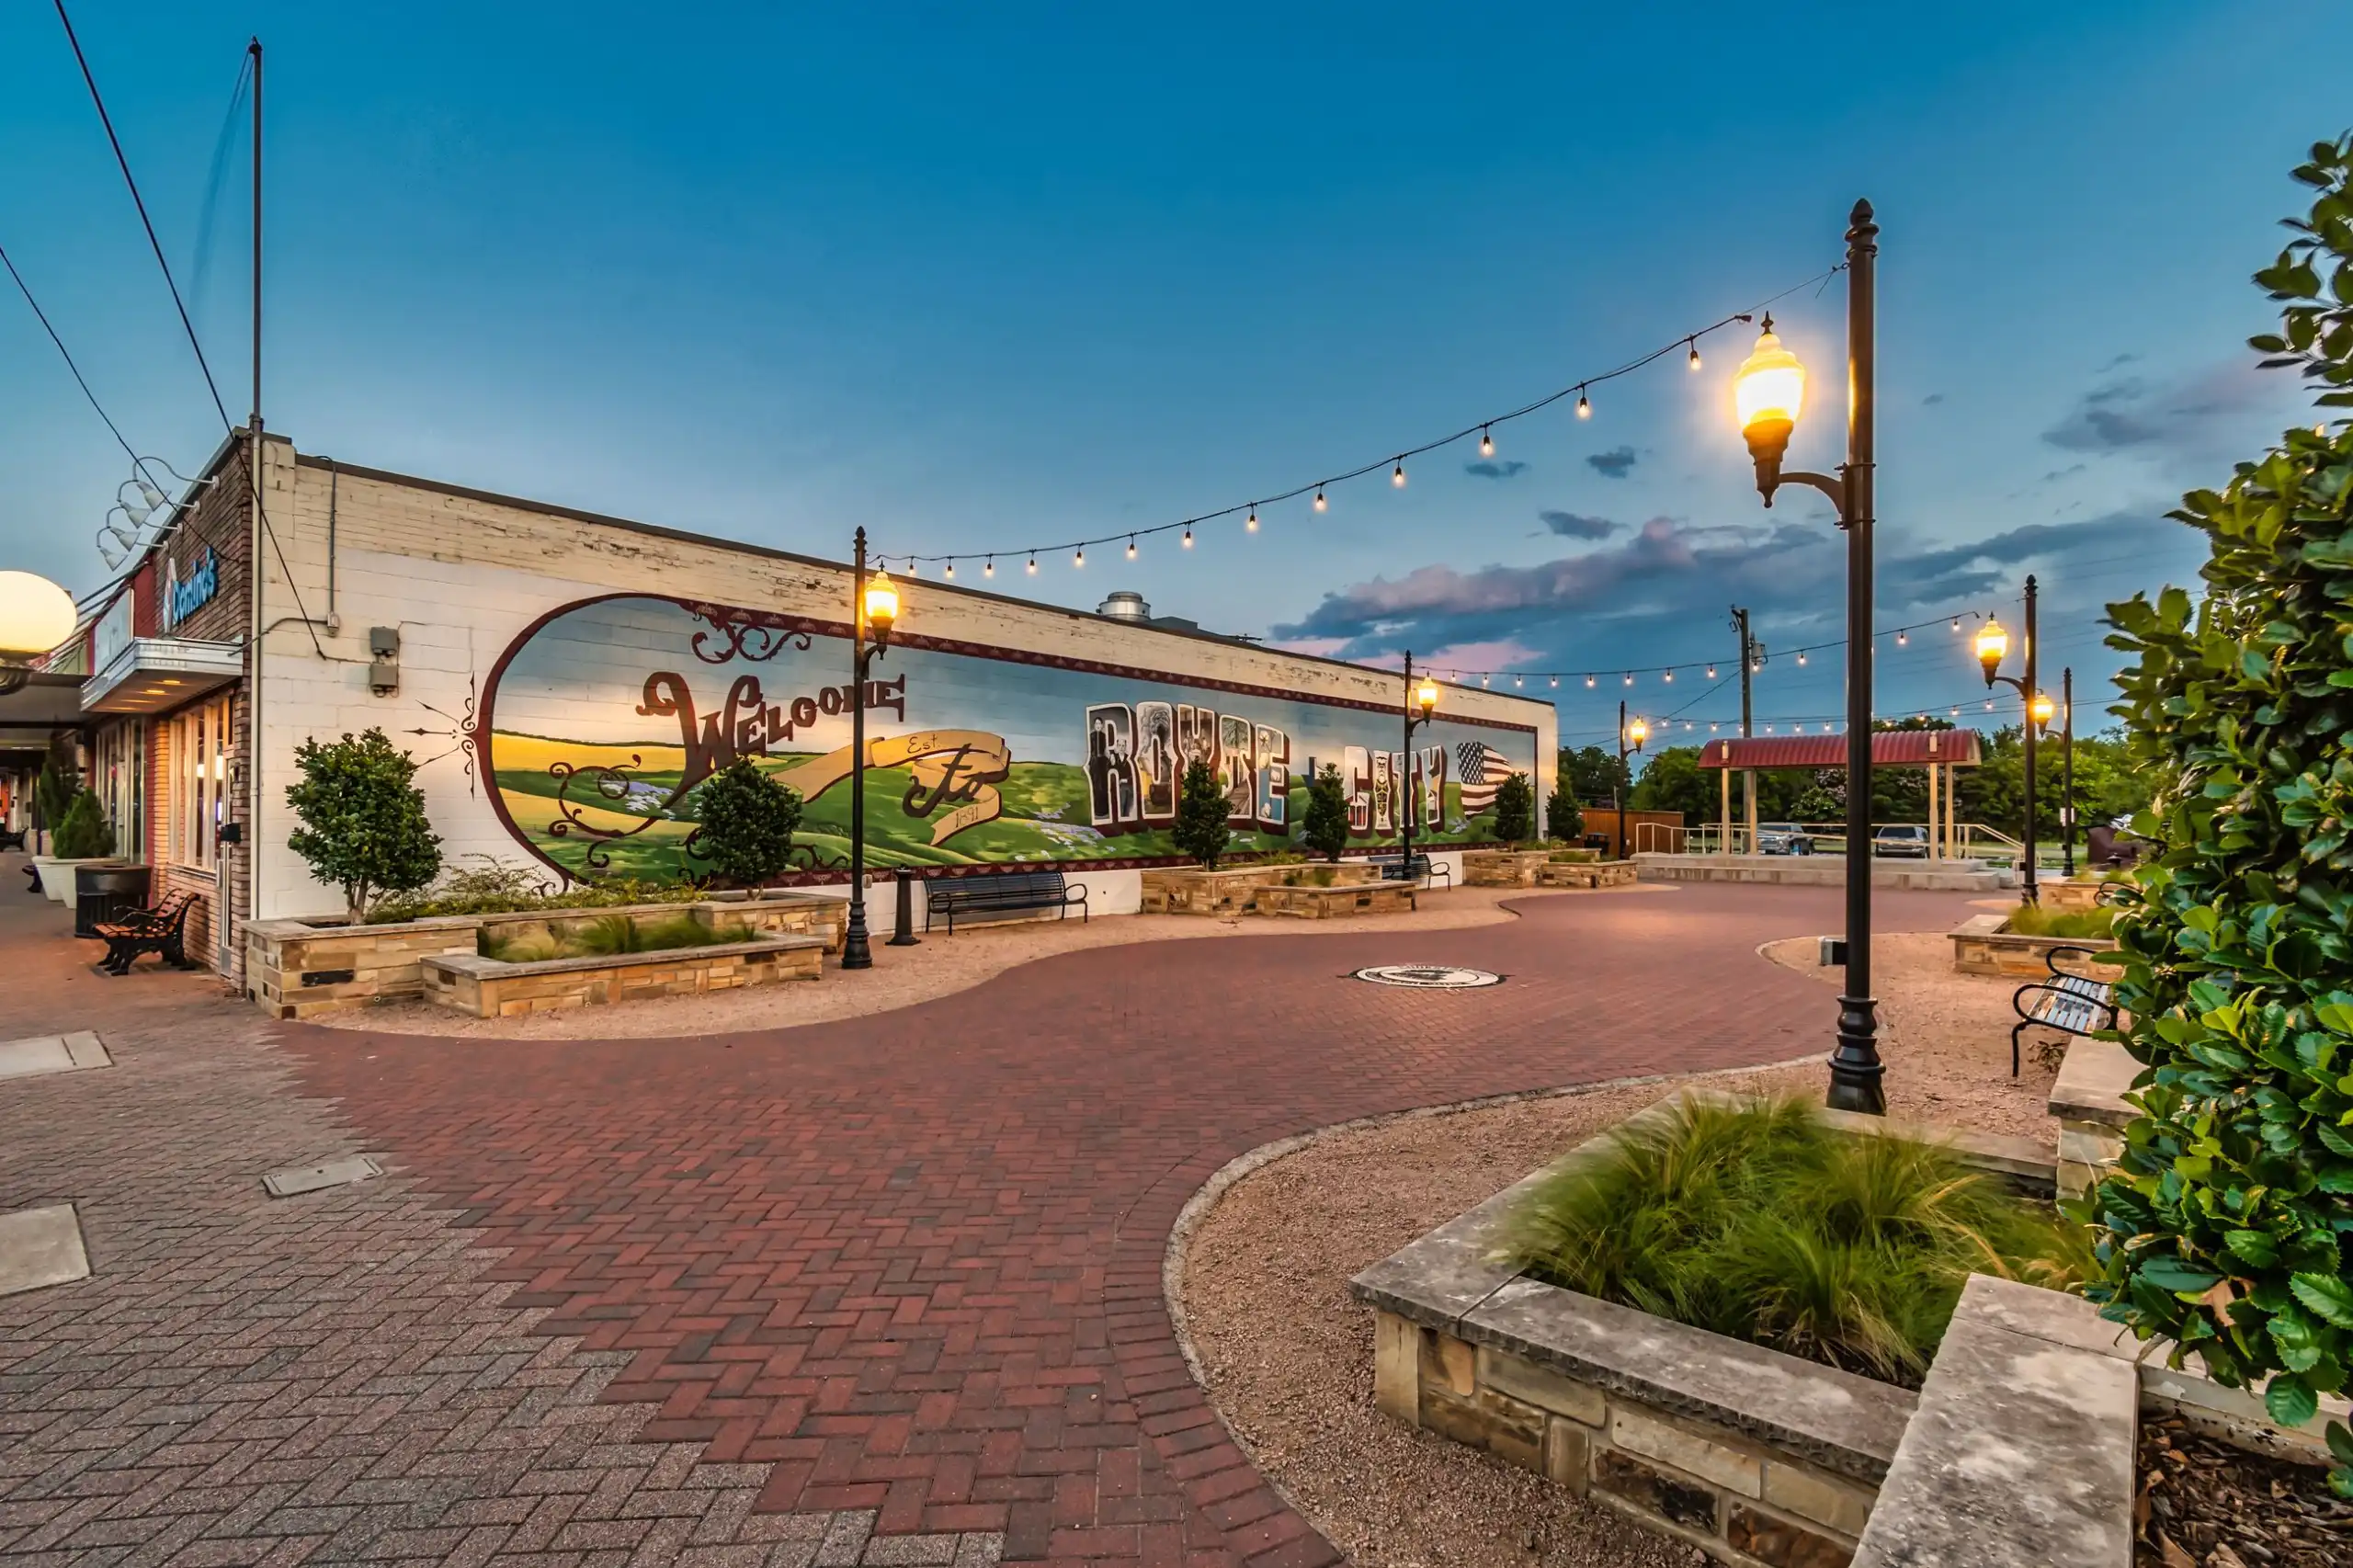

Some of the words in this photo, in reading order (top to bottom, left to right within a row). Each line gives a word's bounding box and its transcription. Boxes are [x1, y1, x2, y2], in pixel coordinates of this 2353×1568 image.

[173, 547, 216, 626] Domino's
[903, 743, 993, 818] to
[1083, 701, 1289, 832] ROYSE
[1343, 744, 1445, 835] CITY
[955, 806, 979, 828] 1891
